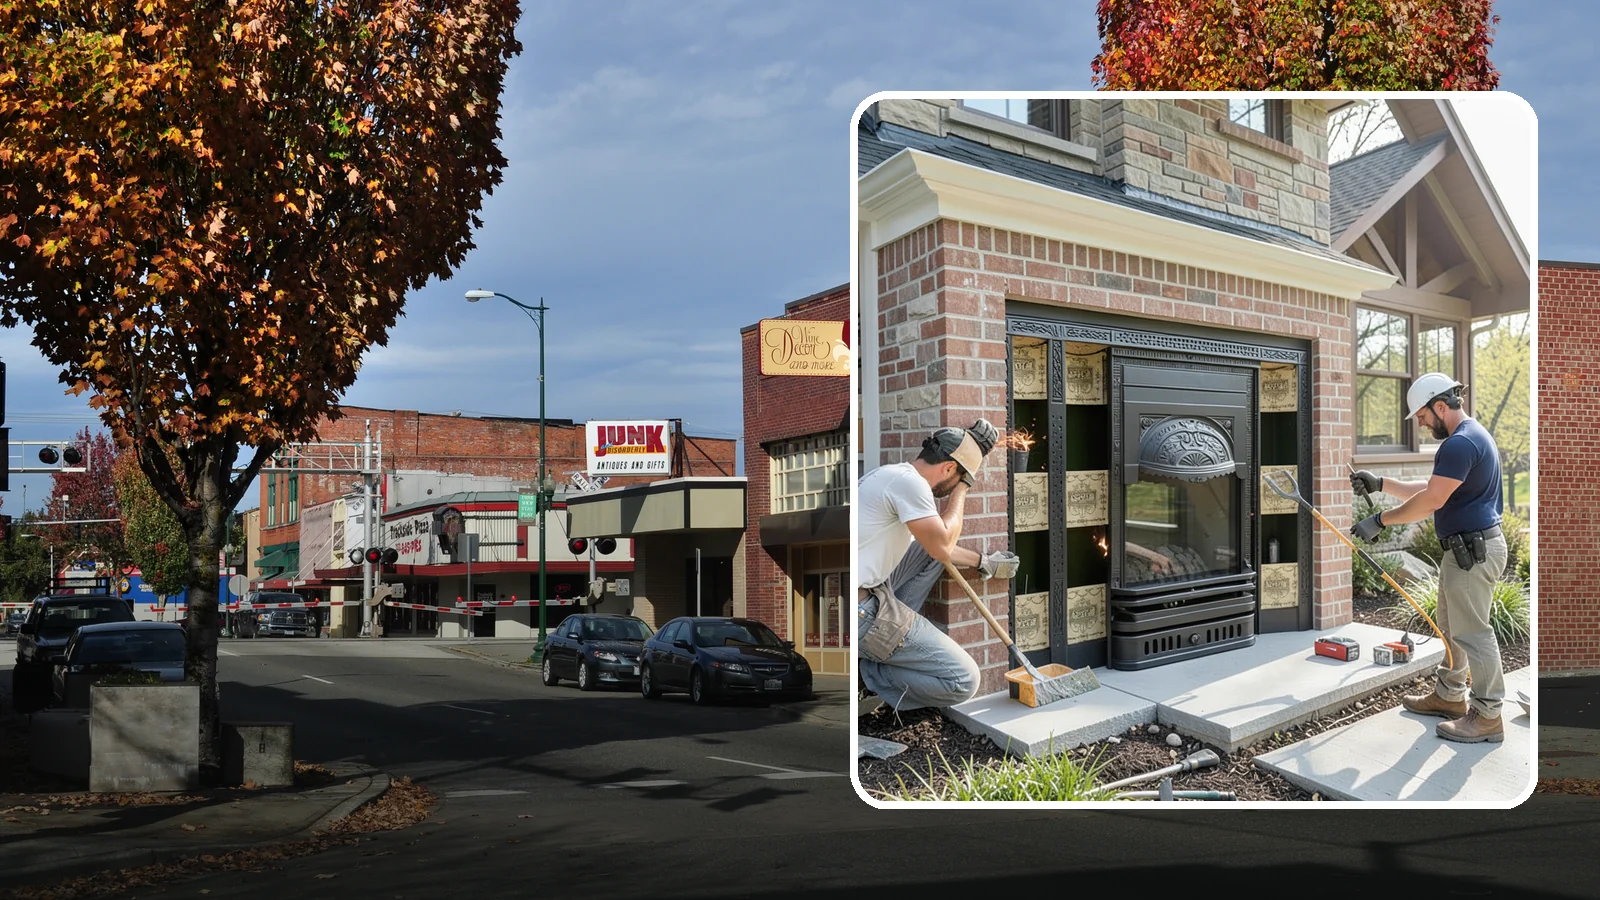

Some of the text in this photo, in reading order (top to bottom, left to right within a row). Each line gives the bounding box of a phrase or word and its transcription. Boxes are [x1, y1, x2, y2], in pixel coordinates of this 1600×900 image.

[595, 424, 666, 458] JUNK
[607, 446, 646, 454] DISORDERLY
[597, 460, 665, 470] ANTIQUES AND GIFTS
[352, 498, 365, 511] CRO
[390, 519, 429, 539] Trackside Pizza
